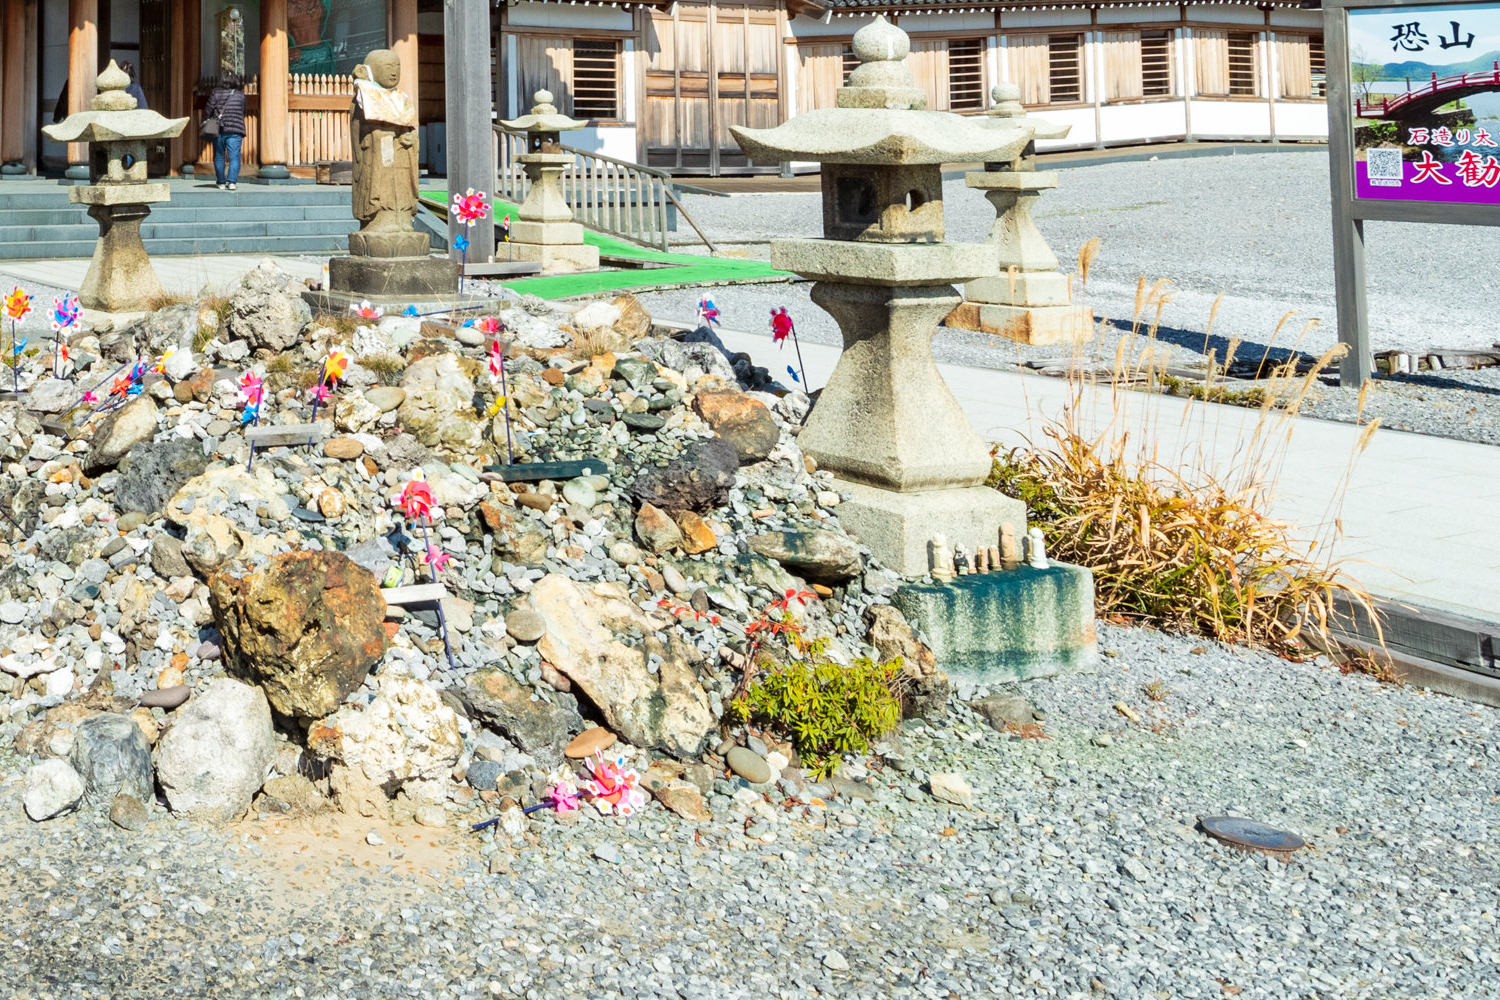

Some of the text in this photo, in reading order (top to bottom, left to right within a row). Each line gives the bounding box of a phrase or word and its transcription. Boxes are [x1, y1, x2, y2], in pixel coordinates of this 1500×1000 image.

[1389, 21, 1476, 52] 恐山
[1407, 127, 1498, 147] 石造り太
[1410, 150, 1500, 188] 大勧
